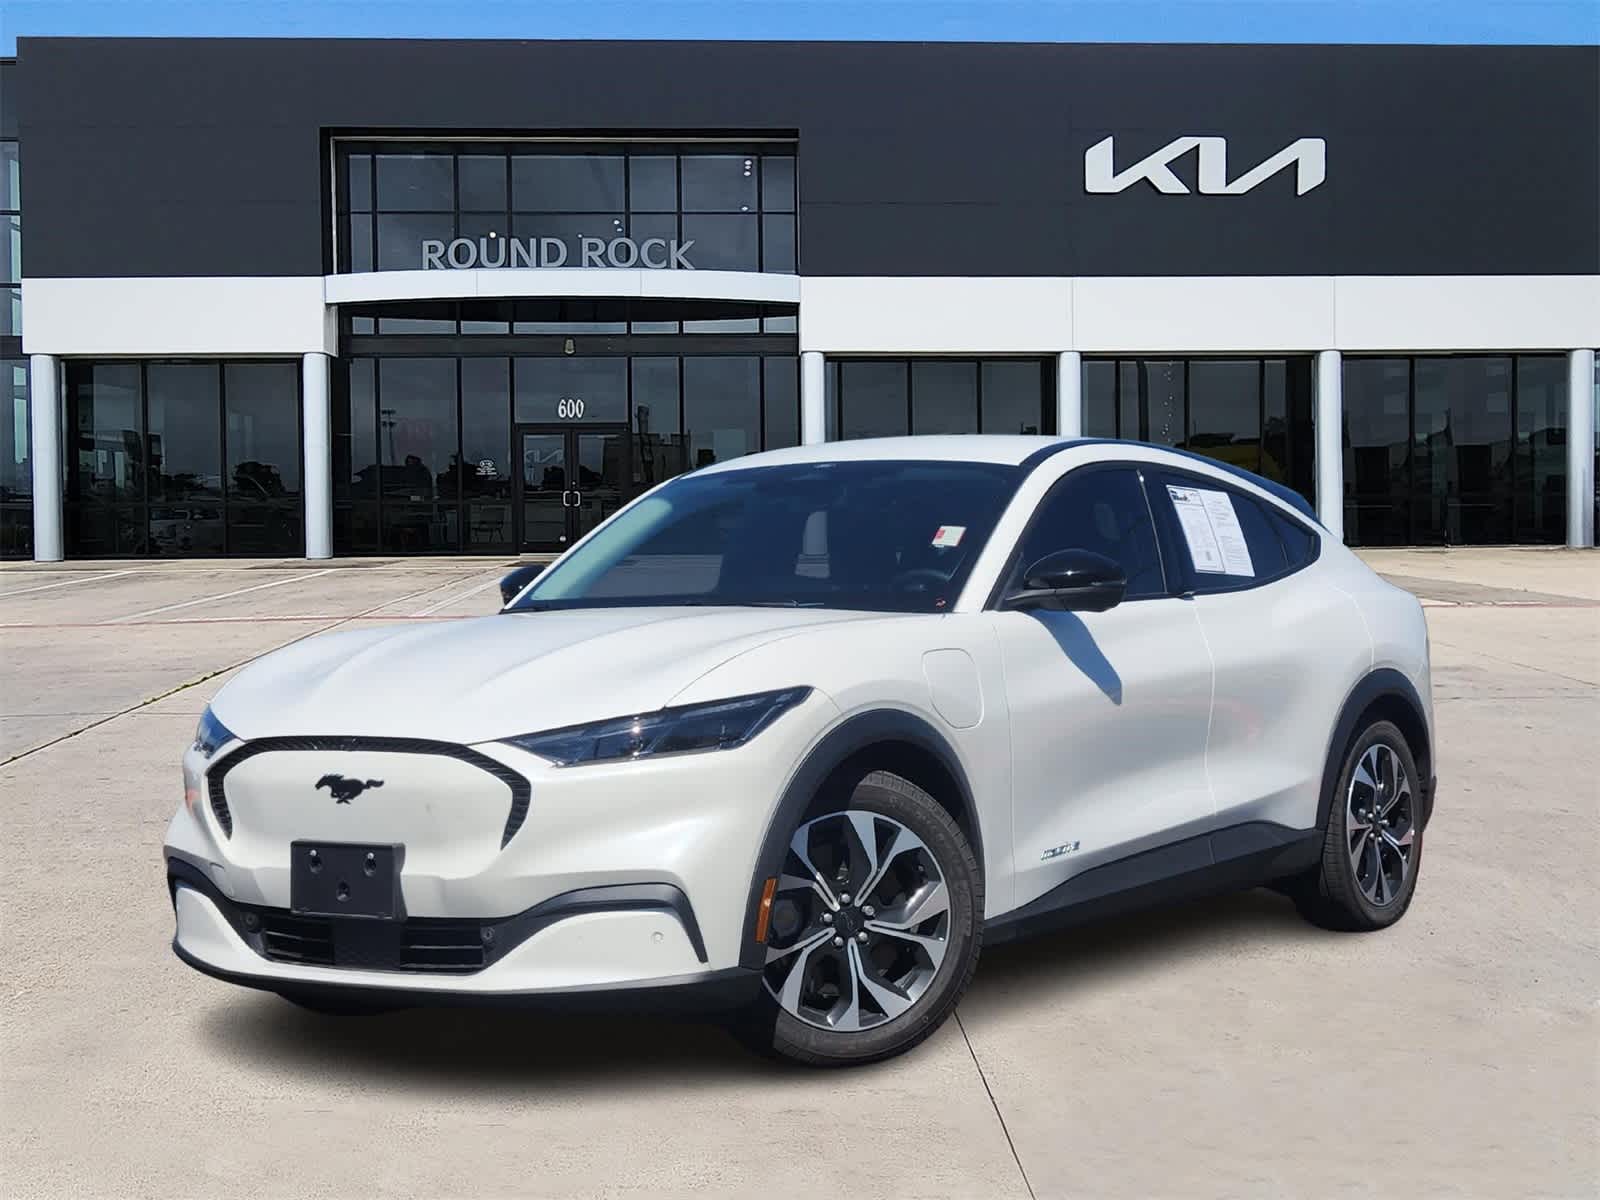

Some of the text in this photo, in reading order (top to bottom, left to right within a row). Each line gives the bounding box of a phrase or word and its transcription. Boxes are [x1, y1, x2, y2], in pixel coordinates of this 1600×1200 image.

[1085, 136, 1326, 196] KIA
[422, 237, 696, 269] ROUND ROCK
[557, 398, 585, 419] 600
